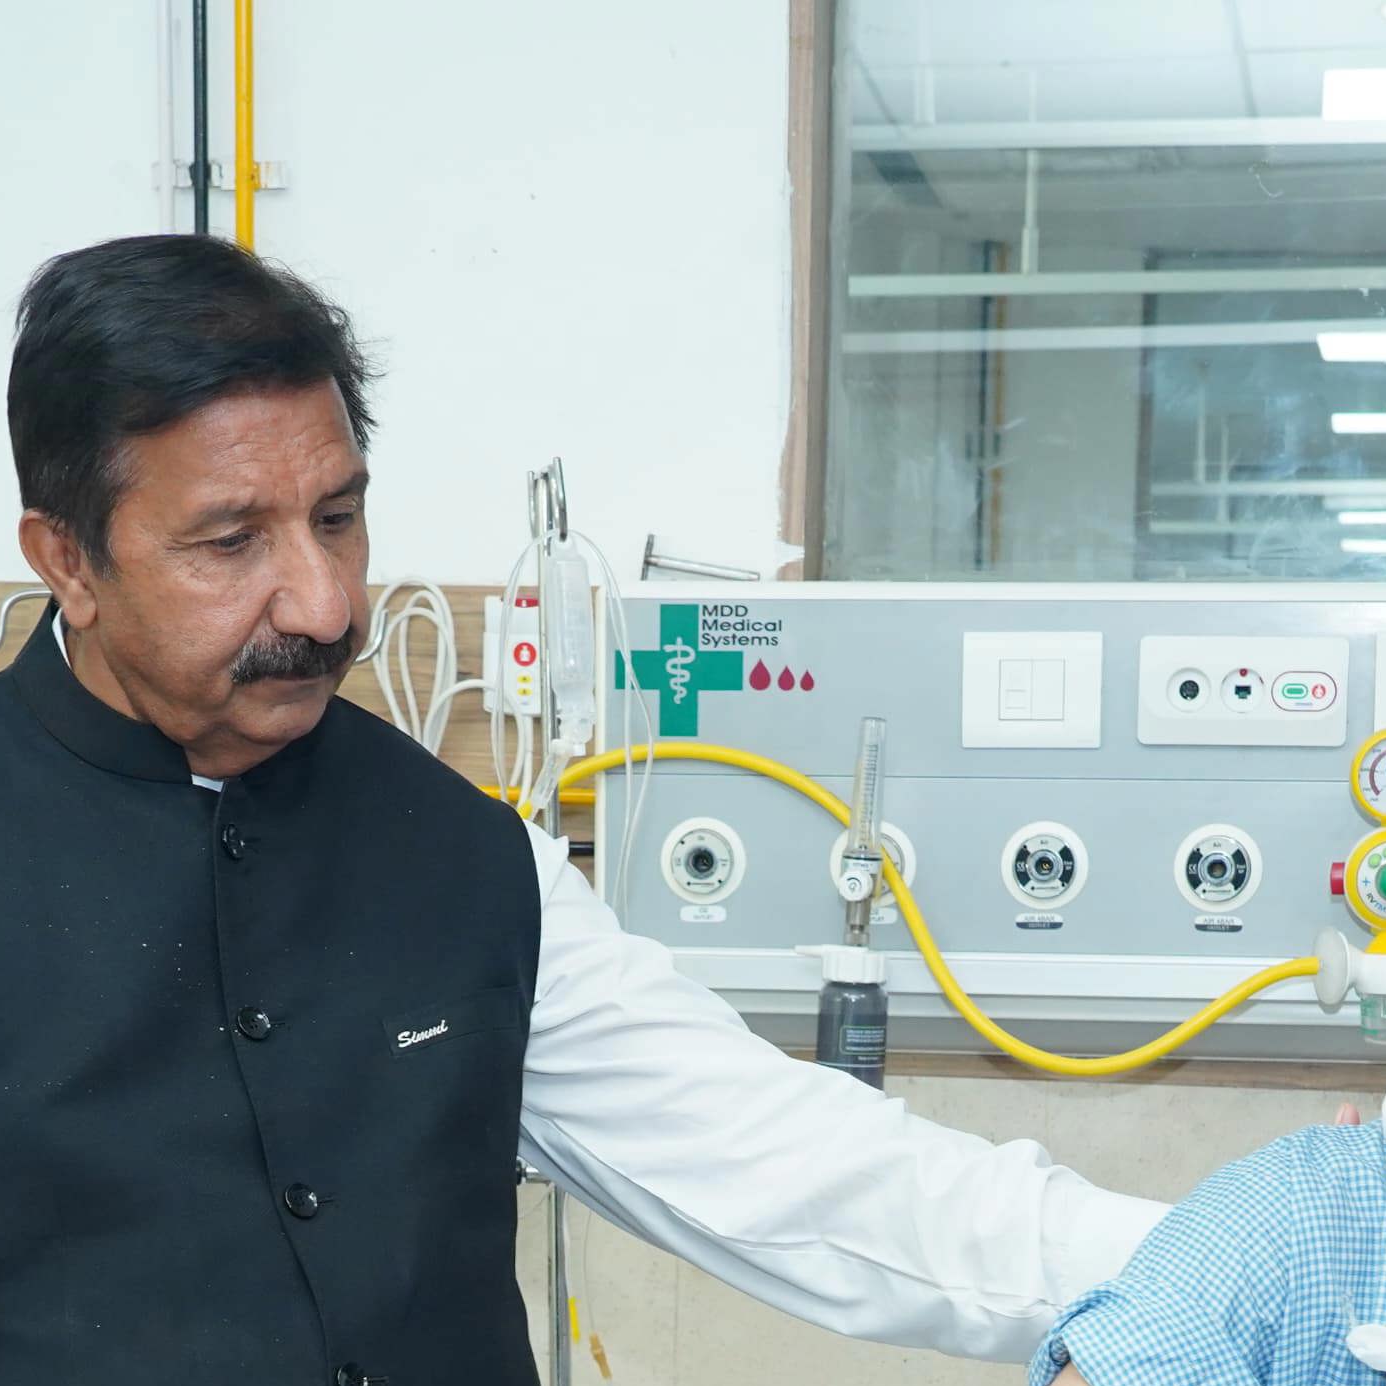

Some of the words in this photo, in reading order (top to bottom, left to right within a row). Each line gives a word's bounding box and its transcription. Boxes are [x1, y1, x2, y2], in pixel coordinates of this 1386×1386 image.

[702, 604, 748, 617] MDD
[702, 619, 782, 632] Medical
[701, 632, 779, 648] Systems
